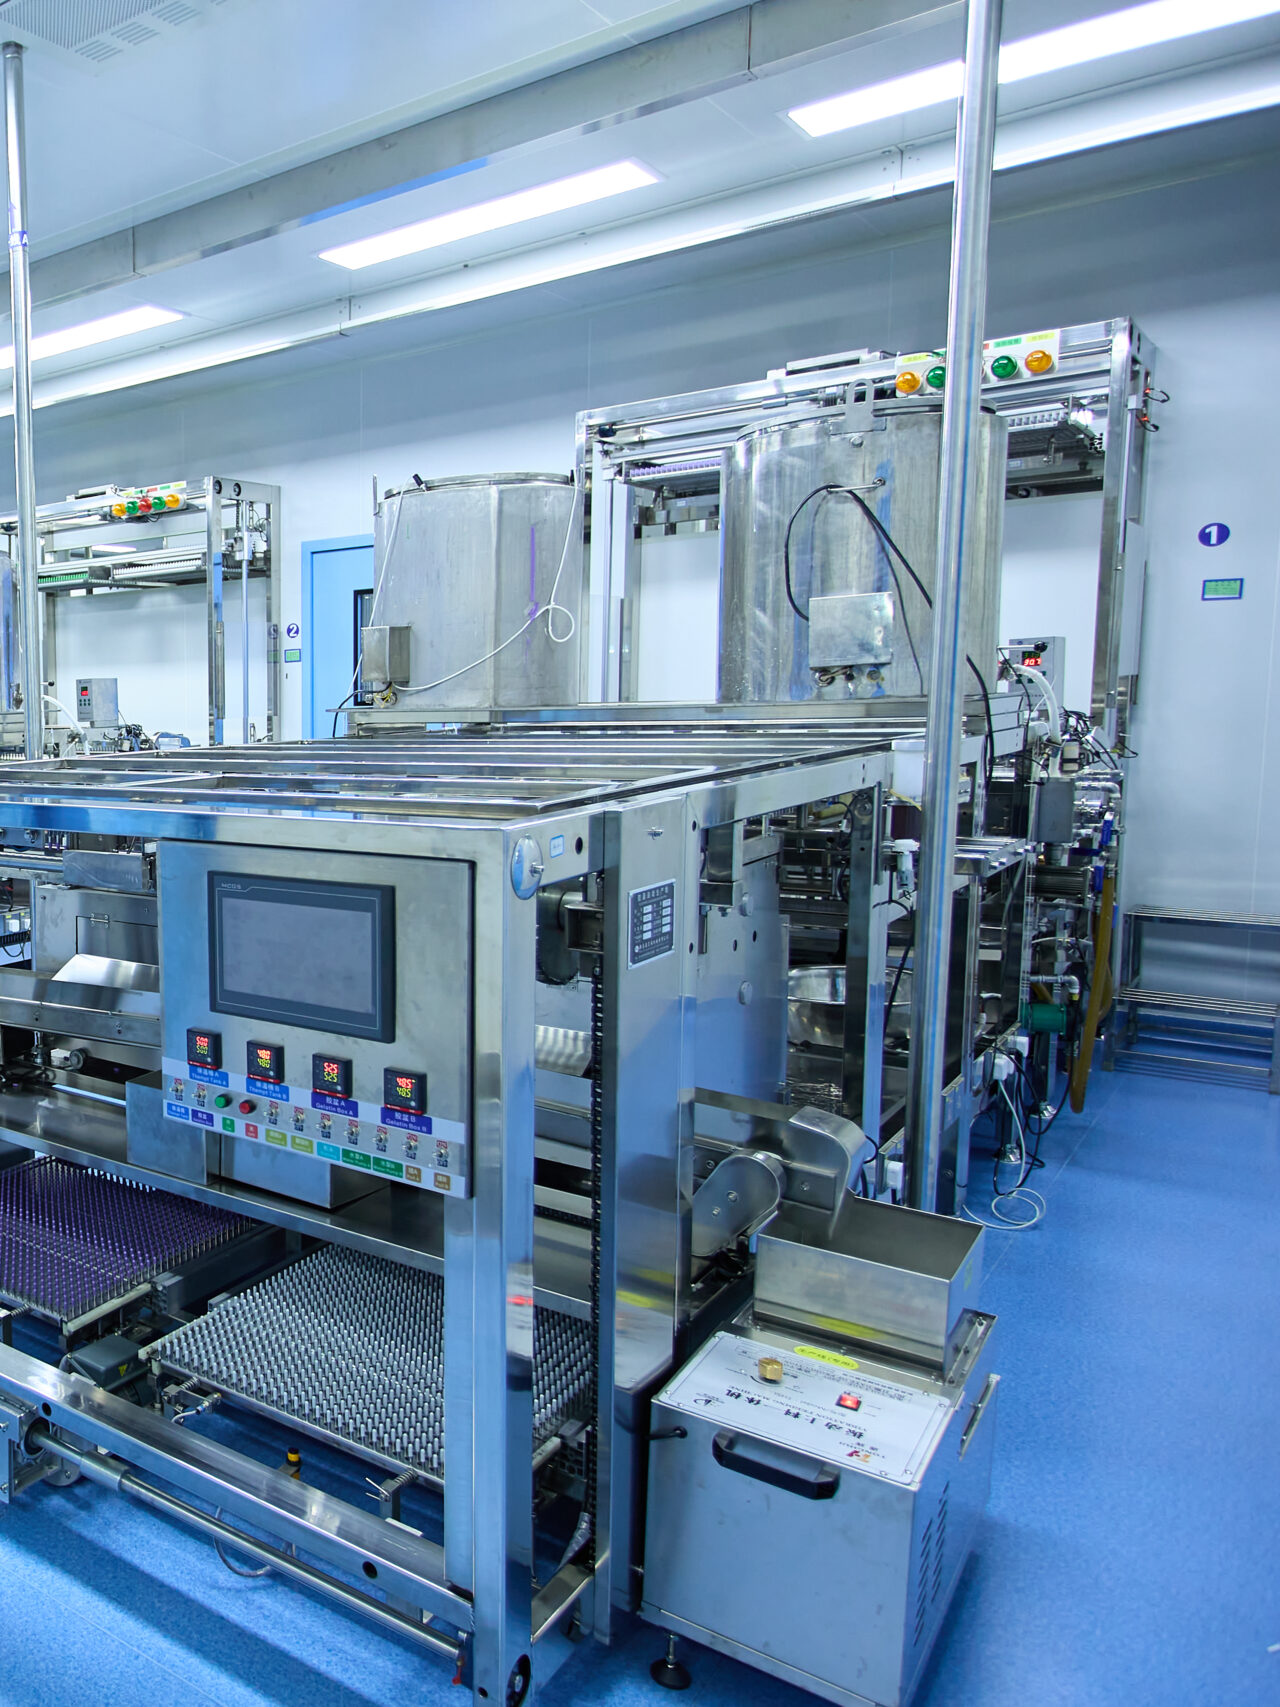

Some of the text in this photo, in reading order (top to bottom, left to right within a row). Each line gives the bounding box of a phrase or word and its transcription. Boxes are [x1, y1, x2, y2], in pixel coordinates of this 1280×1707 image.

[1205, 525, 1218, 545] 1
[289, 624, 297, 637] 2
[316, 1103, 336, 1111] Gelatin
[386, 1118, 408, 1128] Gelatin
[408, 1122, 421, 1131] Box
